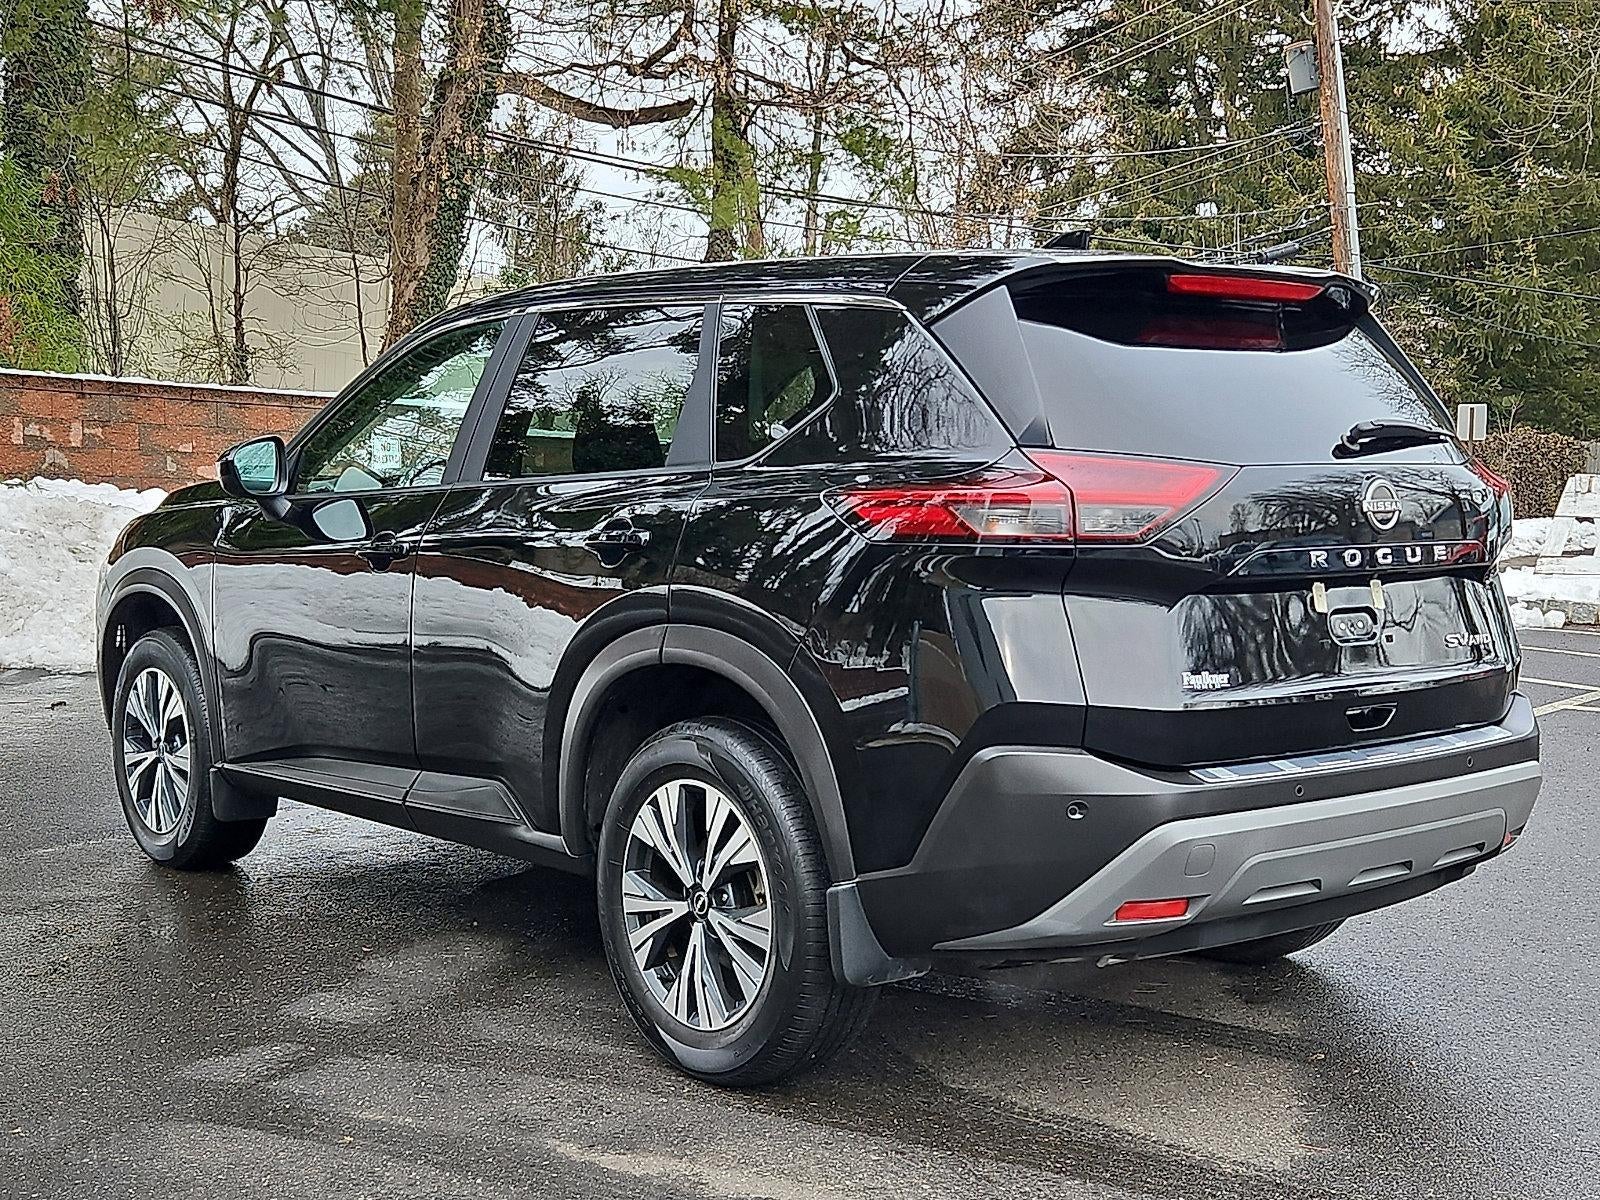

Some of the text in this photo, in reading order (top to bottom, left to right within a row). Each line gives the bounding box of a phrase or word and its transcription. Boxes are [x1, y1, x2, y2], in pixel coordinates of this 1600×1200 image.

[1363, 500, 1402, 512] NISSAN
[1309, 545, 1448, 569] ROGUE
[1181, 670, 1230, 686] Faulkner
